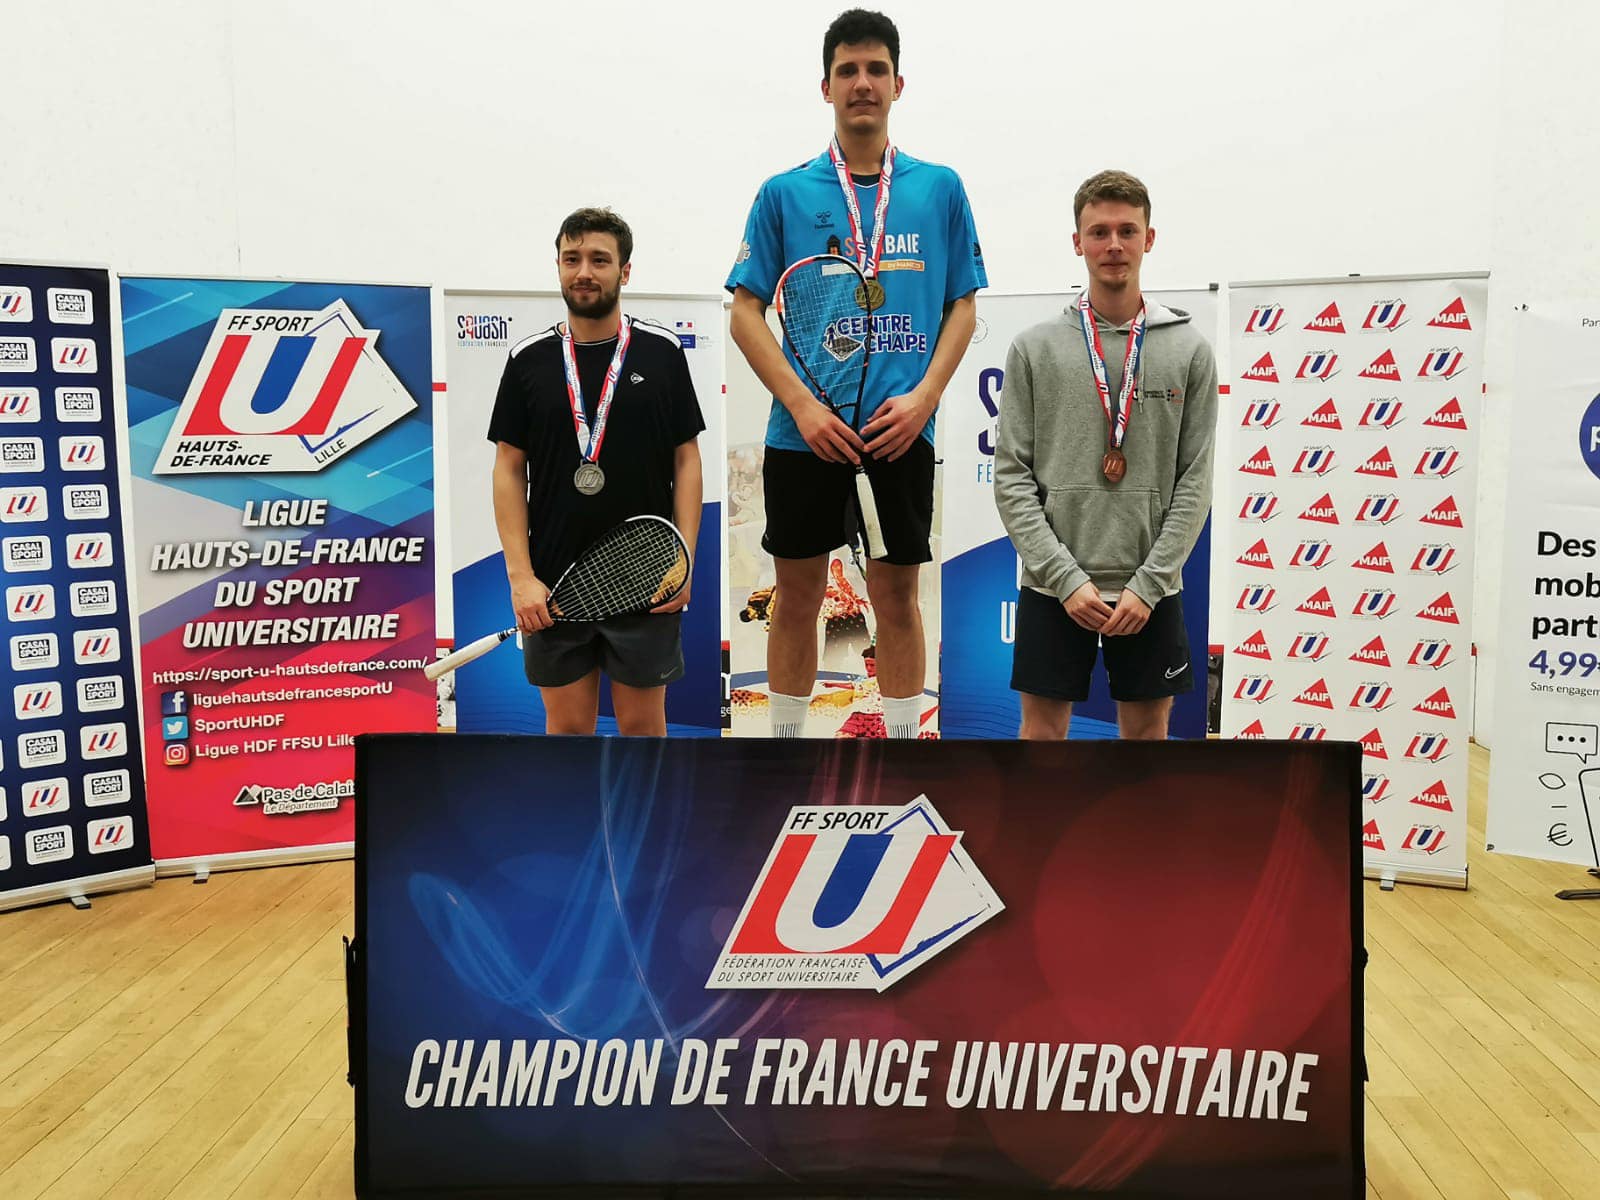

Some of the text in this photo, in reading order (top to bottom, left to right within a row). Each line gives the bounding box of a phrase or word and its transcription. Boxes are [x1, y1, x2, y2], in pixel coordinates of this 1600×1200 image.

[57, 295, 84, 304] CASAL
[57, 302, 85, 310] SPORT
[227, 315, 314, 331] FF SPORT
[1312, 316, 1341, 327] MAIF
[1436, 313, 1465, 323] MAIF
[837, 314, 912, 335] CENTRE
[863, 333, 927, 352] CHAPE
[1249, 366, 1275, 376] MAIF
[1367, 364, 1397, 374] MAIF
[1309, 413, 1338, 423] MAIF
[1432, 412, 1462, 422] MAIF
[4, 444, 34, 452] CASAL
[177, 440, 243, 453] HAUTS-
[314, 438, 347, 465] LILLE
[4, 452, 35, 460] SPORT
[170, 453, 272, 468] DE-FRANCE
[1245, 460, 1272, 469] MAIF
[1364, 461, 1393, 471] MAIF
[72, 492, 100, 500] CASAL
[72, 498, 101, 506] SPORT
[241, 499, 328, 527] LIGUE
[1306, 507, 1335, 517] MAIF
[1428, 510, 1459, 520] MAIF
[12, 543, 41, 552] CASAL
[1537, 531, 1596, 558] Des
[12, 550, 42, 560] SPORT
[150, 537, 424, 571] HAUTS-DE-FRANCE
[1242, 552, 1270, 562] MAIF
[1361, 556, 1390, 566] MAIF
[1535, 572, 1600, 597] mob
[79, 588, 107, 596] CASAL
[213, 577, 360, 608] DU SPORT
[79, 594, 108, 604] SPORT
[1303, 600, 1332, 610] MAIF
[1424, 606, 1455, 616] MAIF
[182, 613, 400, 648] UNIVERSITAIRE
[1532, 614, 1600, 640] part
[20, 641, 49, 650] CASAL
[1240, 643, 1267, 652] MAIF
[20, 648, 50, 658] SPORT
[1357, 649, 1387, 659] MAIF
[1528, 649, 1600, 679] 4,99
[153, 656, 428, 684] https://sport-u-hautsdefrance.com/
[86, 683, 115, 692] CASAL
[1530, 681, 1554, 692] Sans
[86, 690, 116, 700] SPORT
[193, 681, 393, 708] liguehautsdefrancesportU
[1301, 692, 1330, 701] MAIF
[1421, 701, 1452, 710] MAIF
[195, 713, 285, 733] SportUHDF
[27, 737, 56, 747] CASAL
[195, 733, 355, 758] Ligue HDF FFSU Lille
[27, 744, 57, 754] SPORT
[93, 776, 121, 787] CASAL
[93, 783, 122, 794] SPORT
[1418, 793, 1449, 802] MAIF
[265, 803, 277, 812] Le
[790, 811, 889, 830] FF SPORT
[35, 833, 64, 844] CASAL
[1363, 832, 1380, 842] AIF
[35, 840, 65, 852] SPORT
[722, 955, 865, 970] FÉDÉRATION FRANÇAISE
[717, 971, 860, 982] DU SPORT UNIVERSITAIRE
[403, 1038, 1319, 1122] CHAMPION DE FRANCE UNIVERSITAIRE
